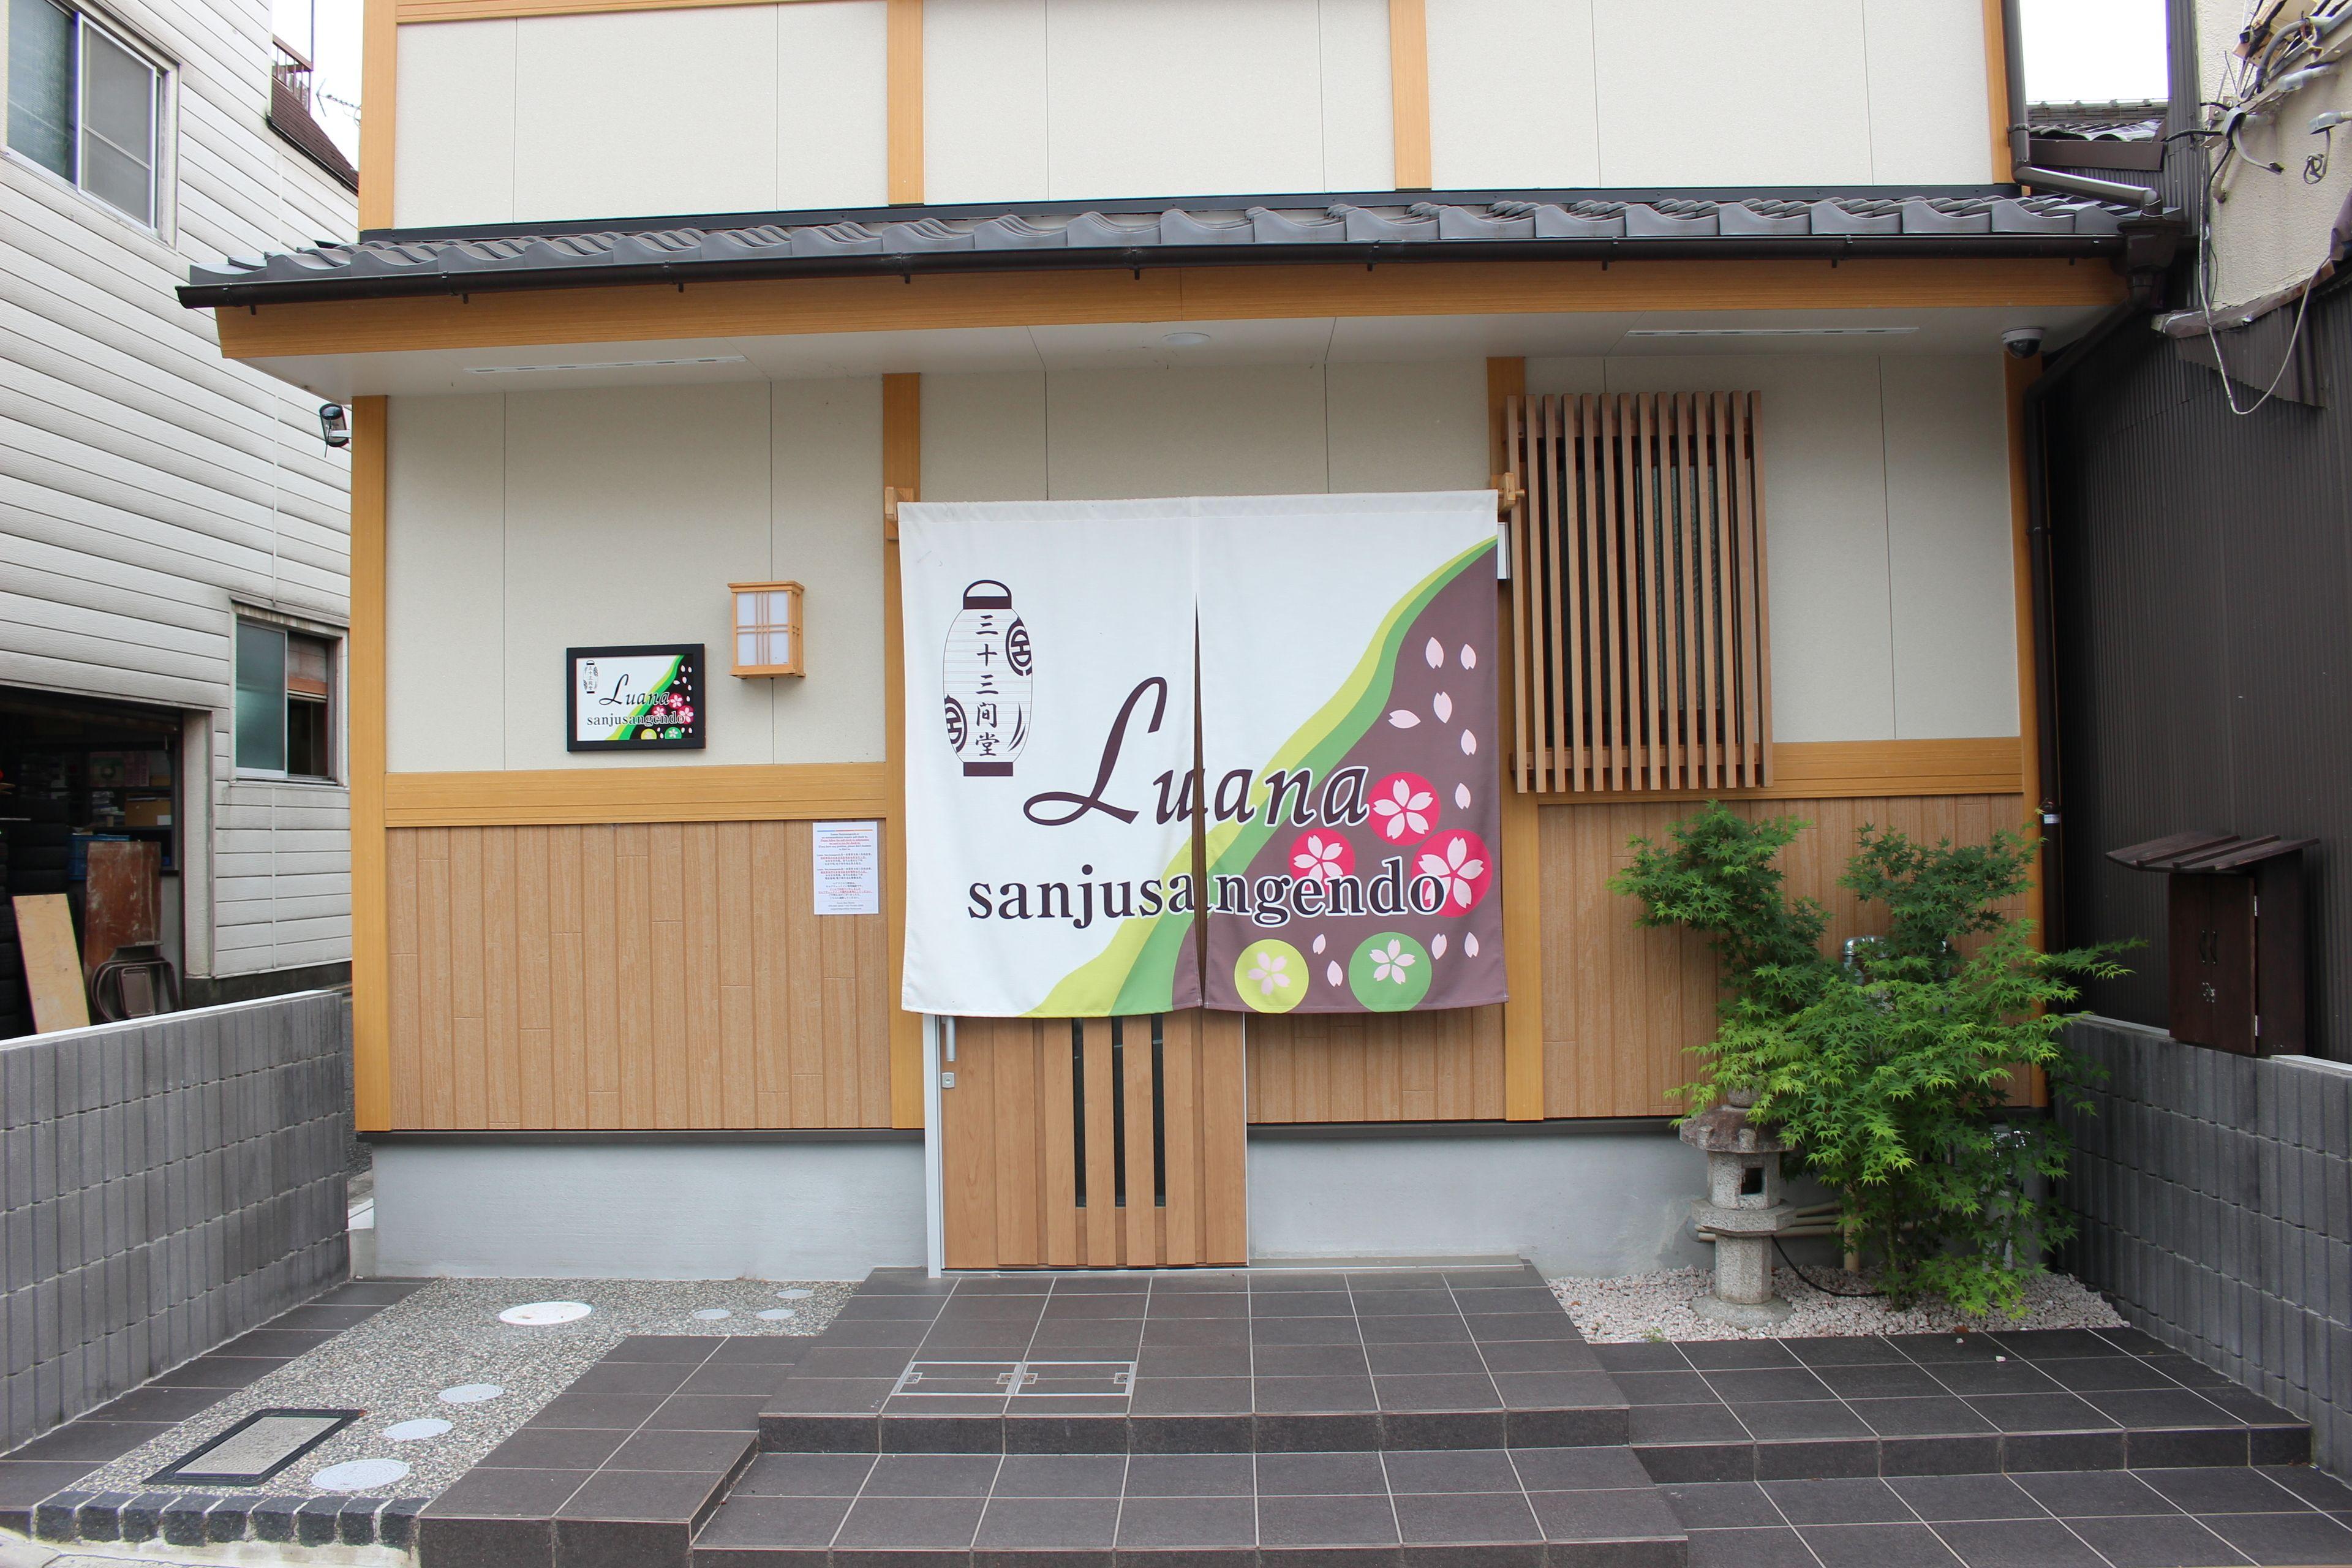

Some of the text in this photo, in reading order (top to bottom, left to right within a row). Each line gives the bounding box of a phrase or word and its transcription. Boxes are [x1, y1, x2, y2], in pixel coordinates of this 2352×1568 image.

[599, 674, 670, 705] Luana
[587, 711, 685, 726] sanjusangendo
[1023, 676, 1370, 827] Luana
[967, 856, 1446, 928] sanjusangendo
